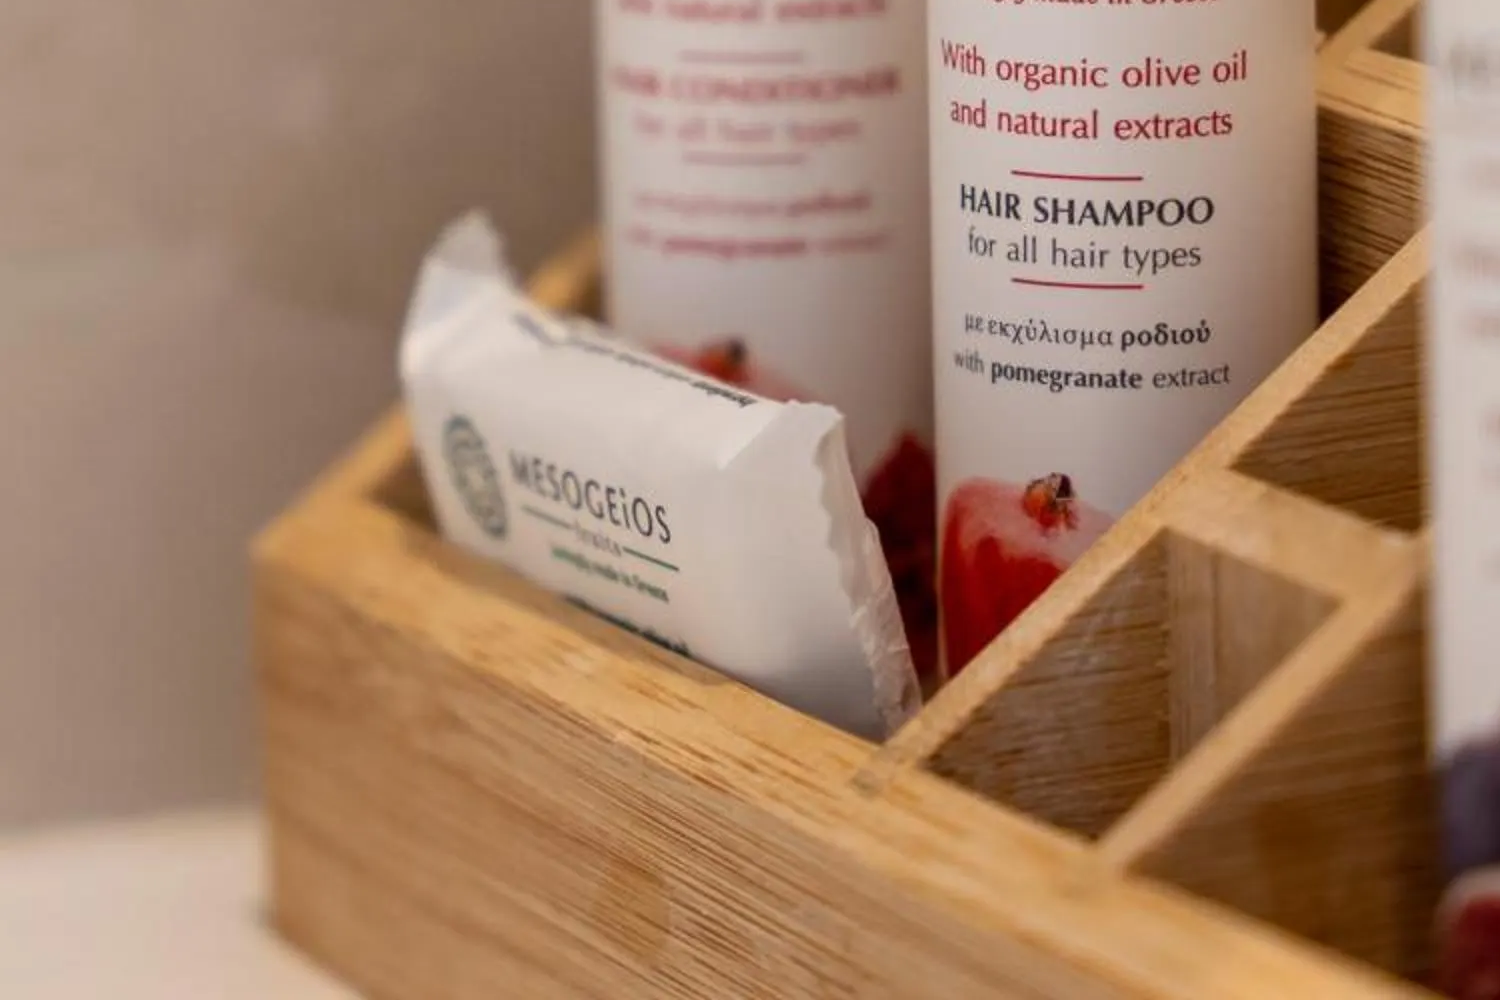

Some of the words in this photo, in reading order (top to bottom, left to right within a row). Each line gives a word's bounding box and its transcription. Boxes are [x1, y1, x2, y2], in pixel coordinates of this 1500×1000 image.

[940, 38, 986, 79] With
[995, 54, 1109, 92] organic
[1121, 56, 1201, 88] olive
[1212, 49, 1248, 85] oil
[950, 98, 987, 130] and
[997, 107, 1099, 141] natural
[1113, 109, 1234, 141] extracts
[959, 182, 1022, 223] HAIR
[1033, 196, 1216, 228] SHAMPOO
[966, 226, 997, 259] for
[1005, 234, 1038, 265] all
[1050, 237, 1110, 269] hair
[1122, 242, 1202, 277] types
[963, 311, 984, 333] με
[987, 317, 1114, 350] εκχύλισμα
[1120, 319, 1215, 351] ροδιού
[953, 349, 985, 375] with
[990, 360, 1144, 393] pomegranate
[1152, 364, 1231, 389] extract
